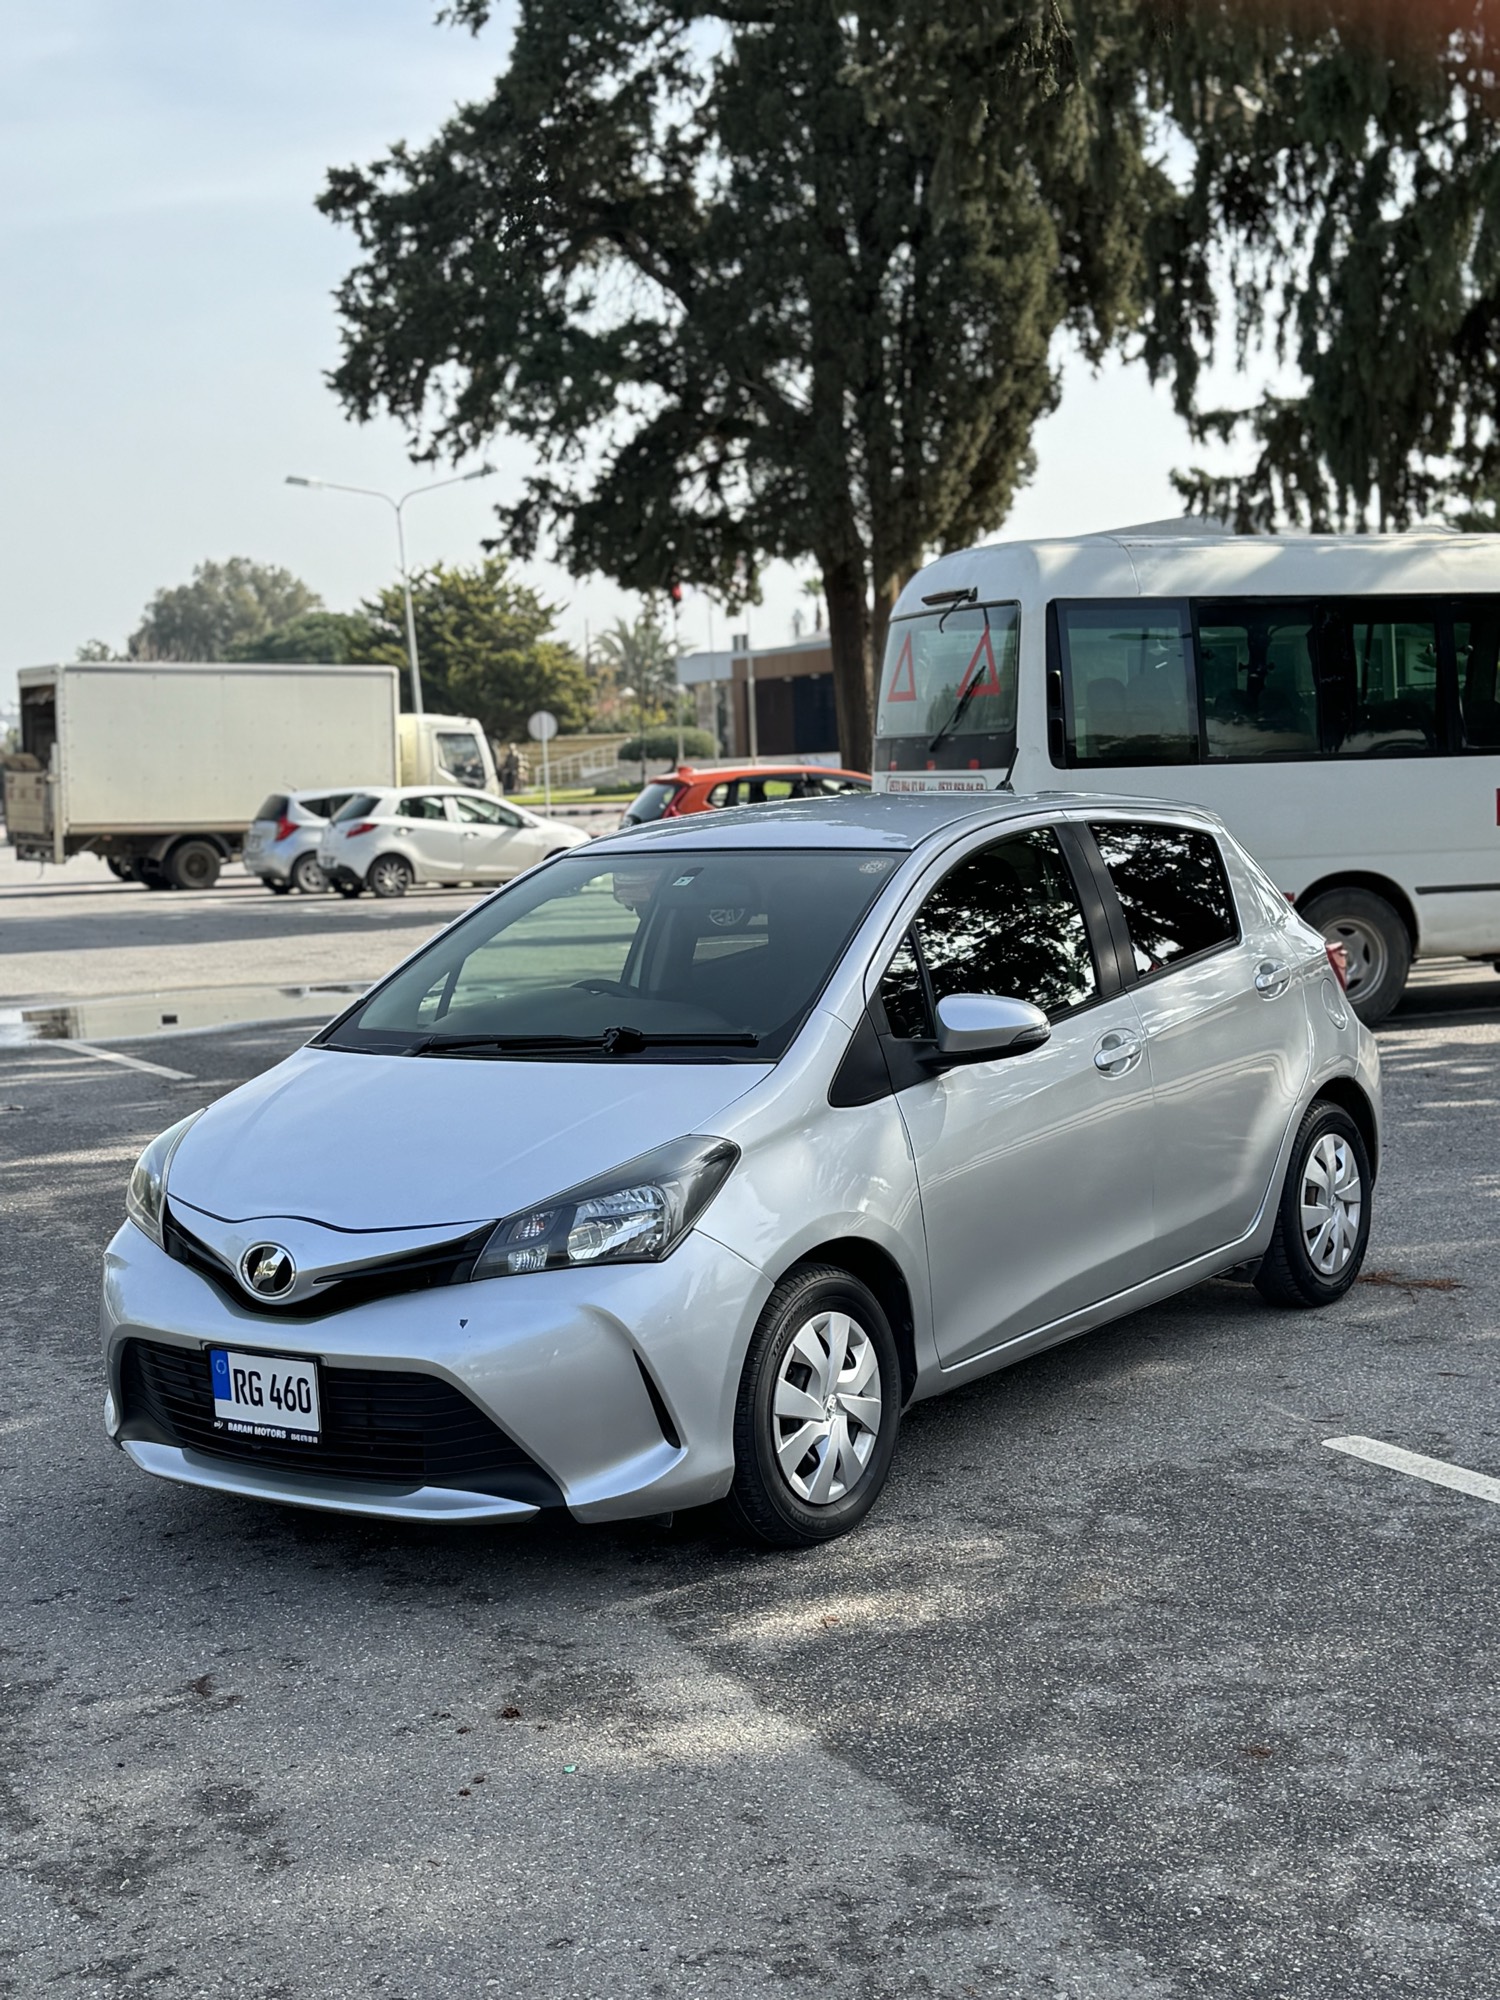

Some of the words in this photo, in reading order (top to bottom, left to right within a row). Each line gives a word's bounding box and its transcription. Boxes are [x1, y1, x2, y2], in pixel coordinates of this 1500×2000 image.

[233, 1368, 264, 1407] RG
[269, 1373, 312, 1414] 460
[254, 1426, 287, 1439] MOTORS
